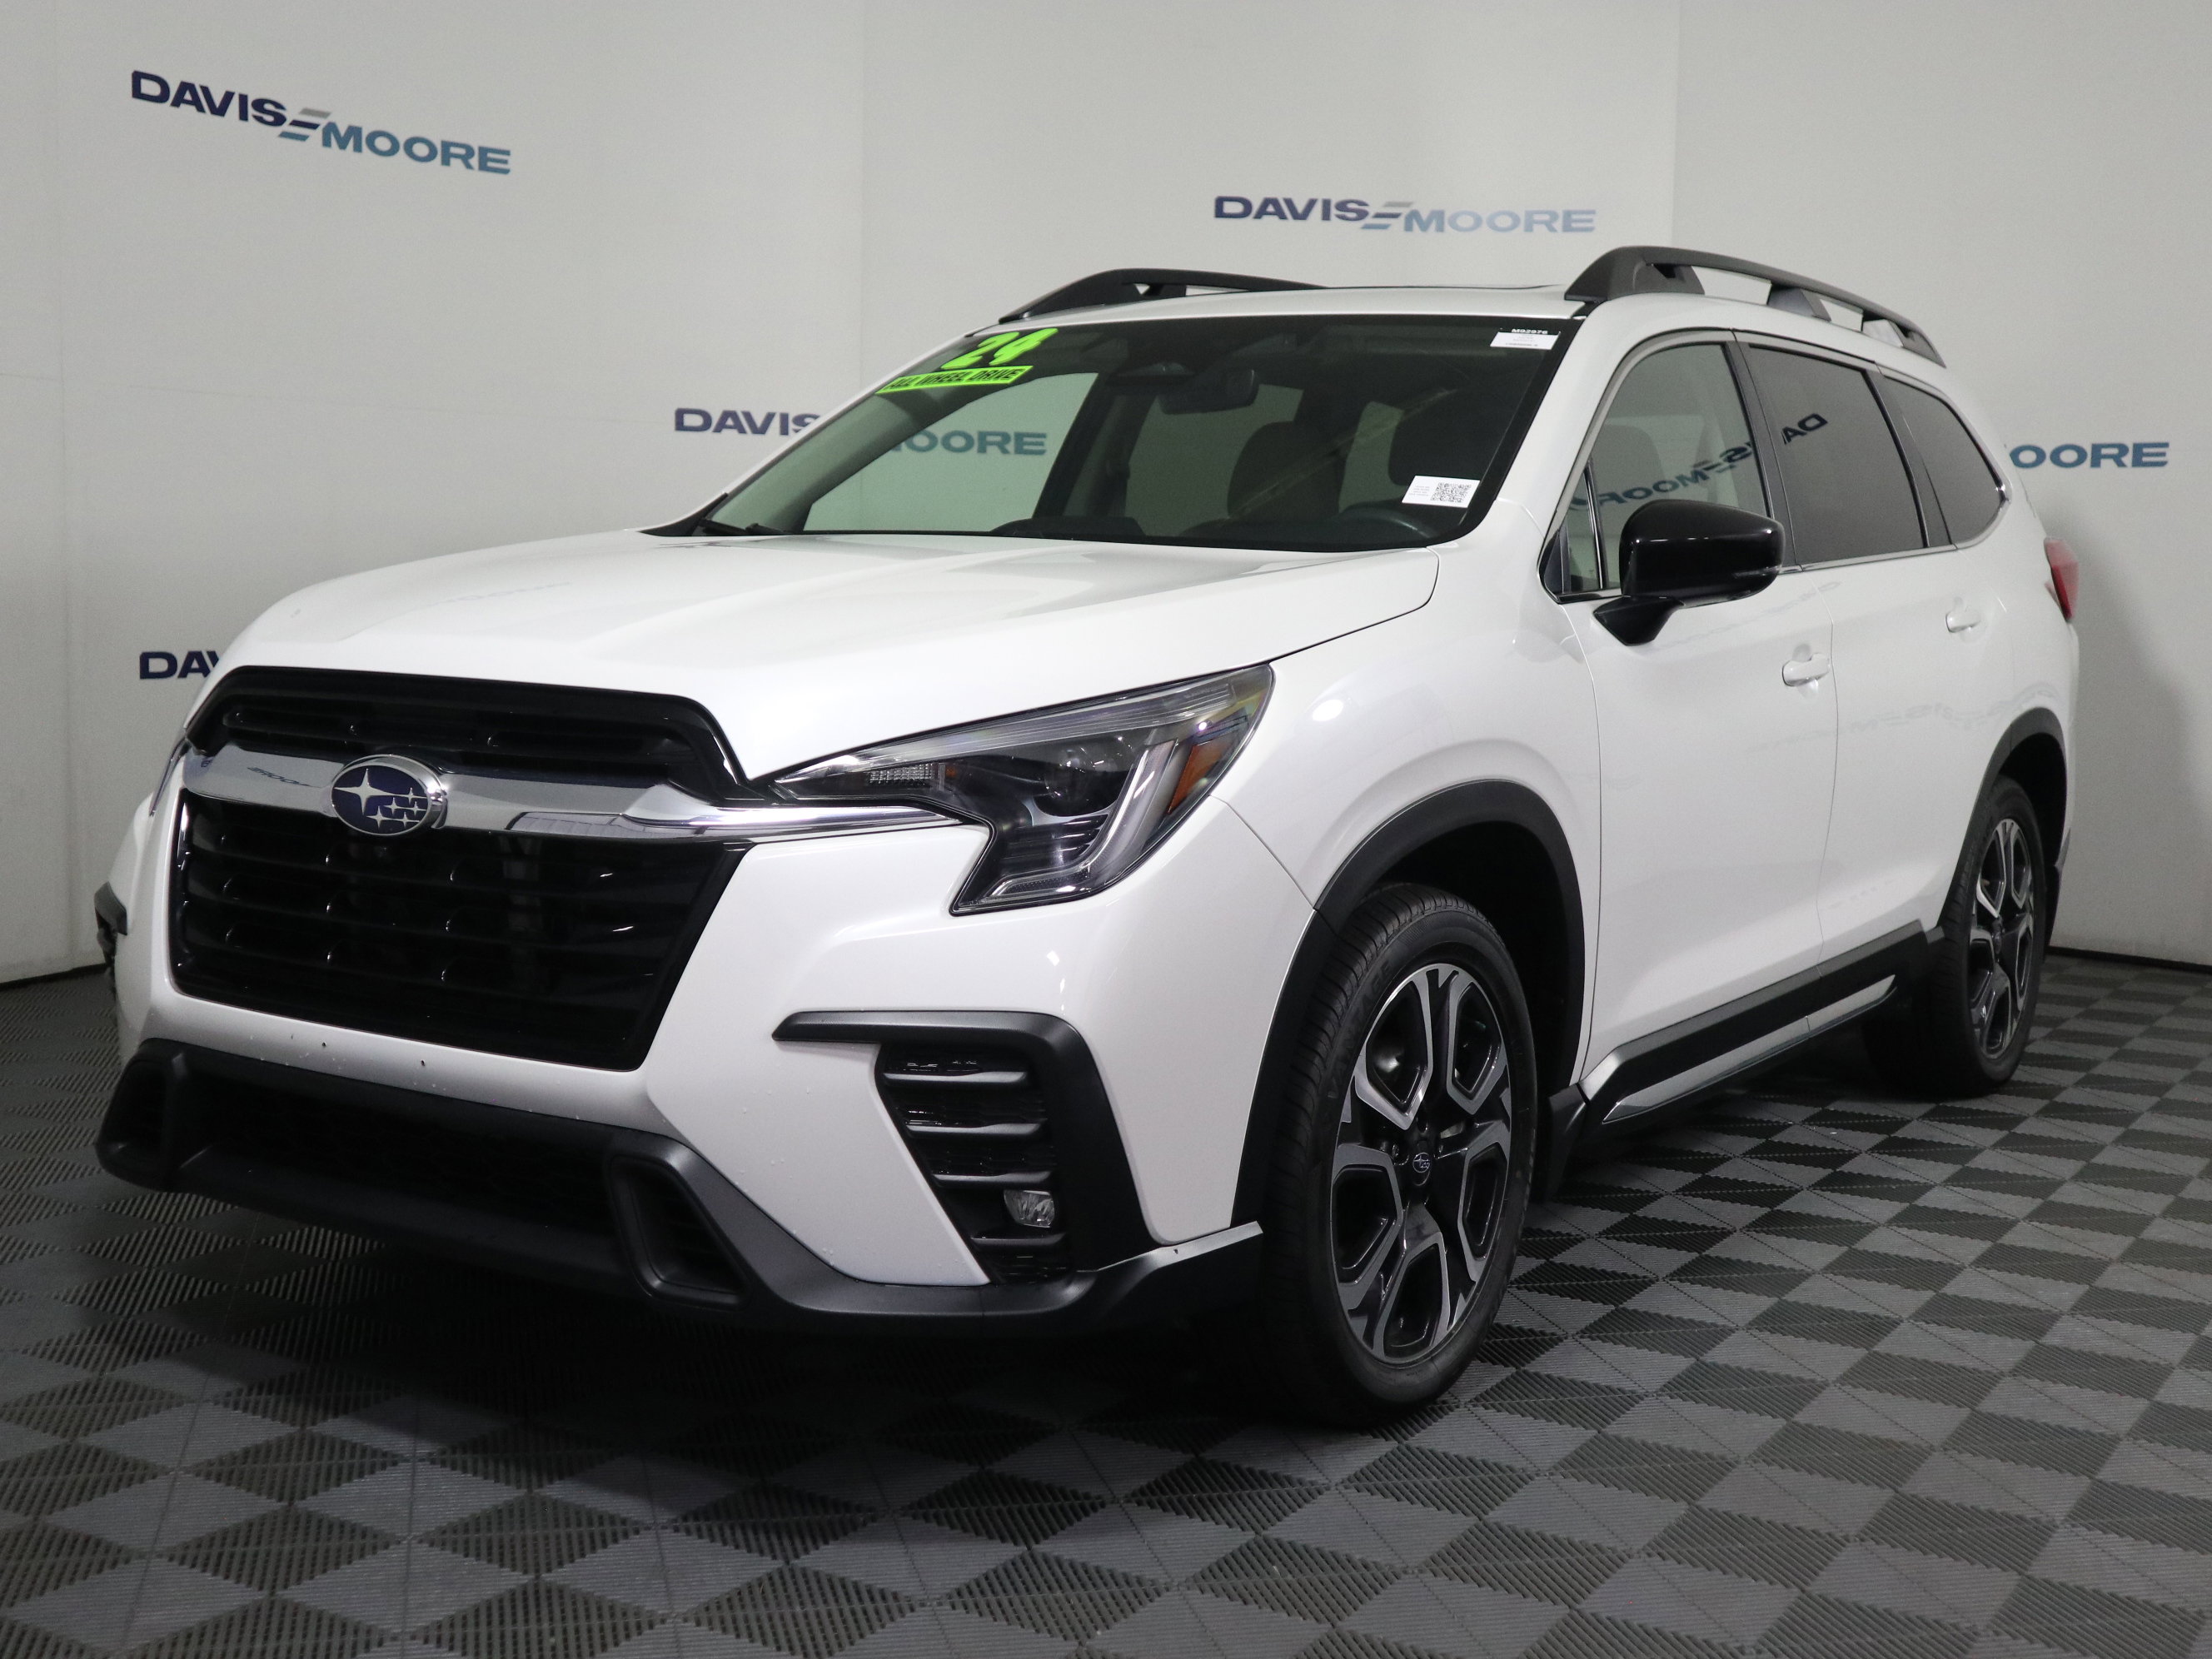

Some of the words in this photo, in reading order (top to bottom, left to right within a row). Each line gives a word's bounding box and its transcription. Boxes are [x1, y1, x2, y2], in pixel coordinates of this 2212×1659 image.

[132, 70, 287, 127] DAVIS
[321, 122, 511, 175] MOORE
[1214, 196, 1369, 222] DAVIS
[1404, 209, 1597, 232] MOORE
